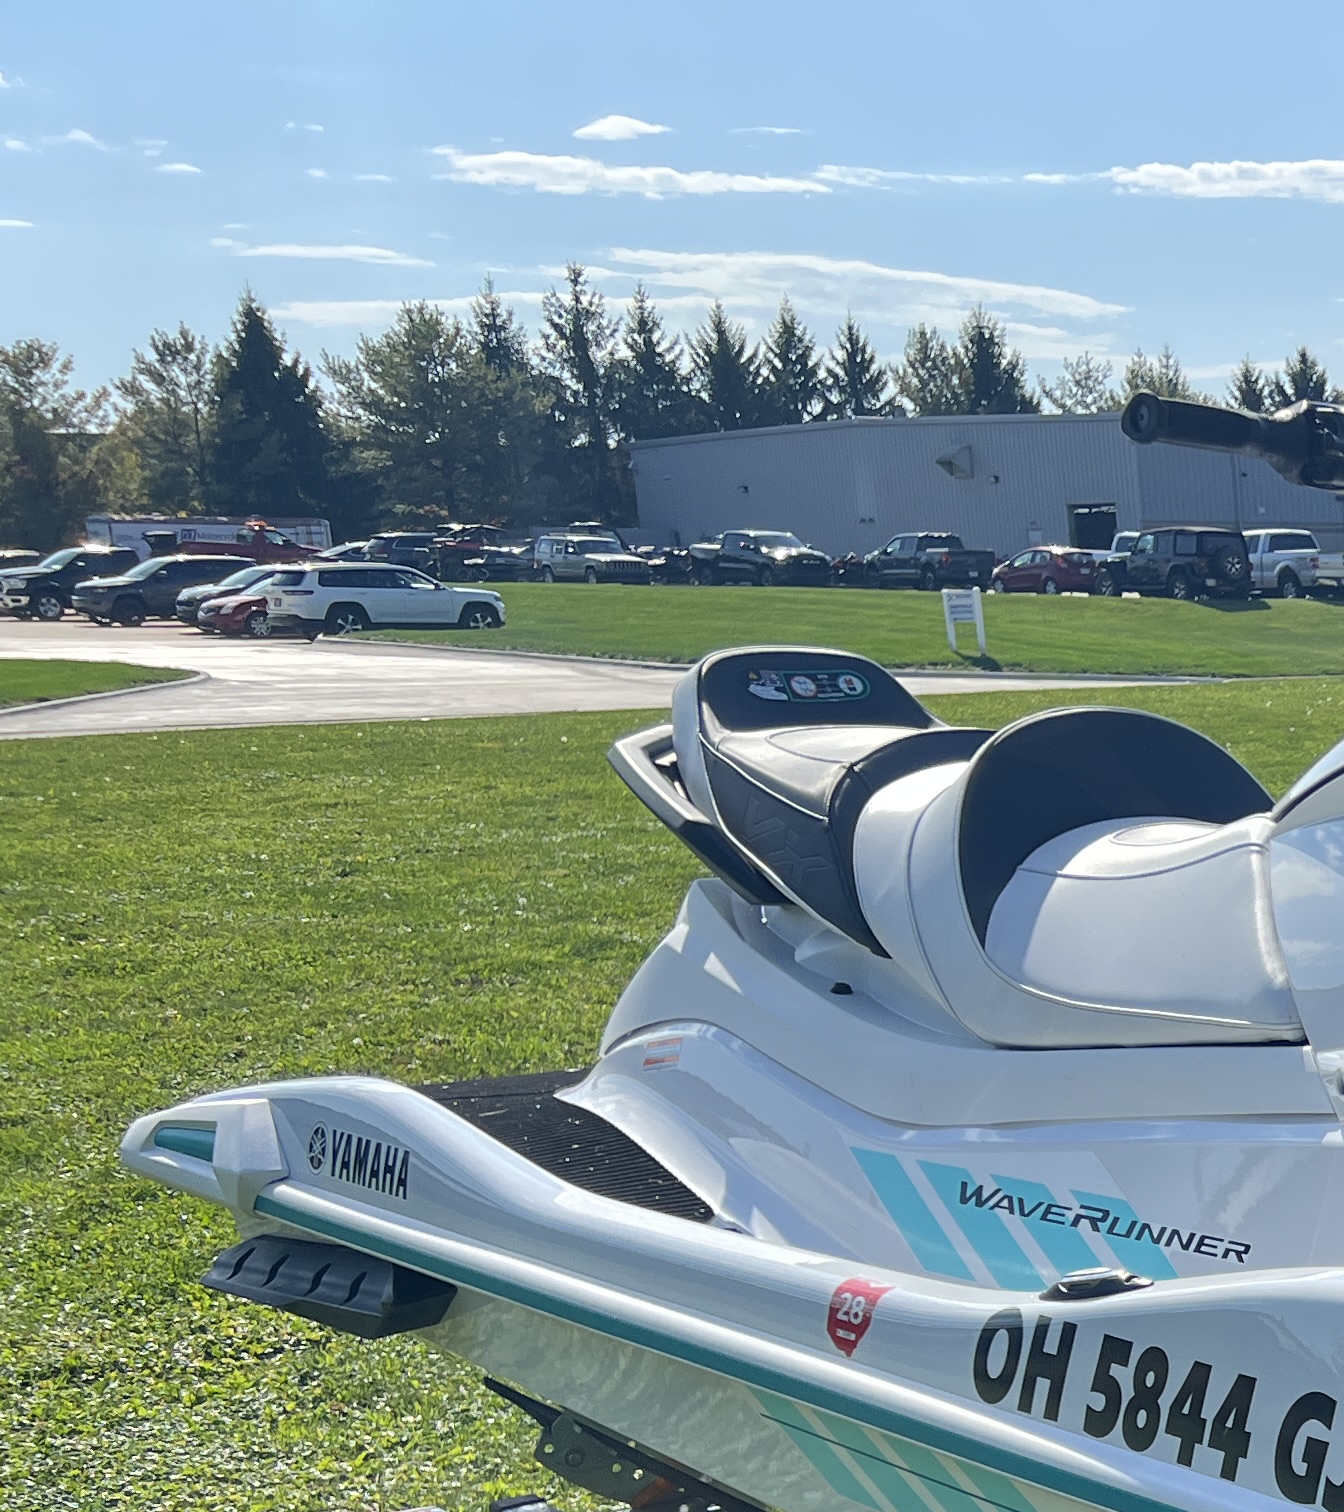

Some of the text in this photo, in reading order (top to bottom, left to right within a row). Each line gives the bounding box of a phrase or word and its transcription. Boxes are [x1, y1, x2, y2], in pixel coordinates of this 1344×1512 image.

[331, 1129, 410, 1200] YAMAHA
[836, 1292, 866, 1325] 28
[973, 1308, 1077, 1423] OH
[1083, 1333, 1257, 1481] 5844
